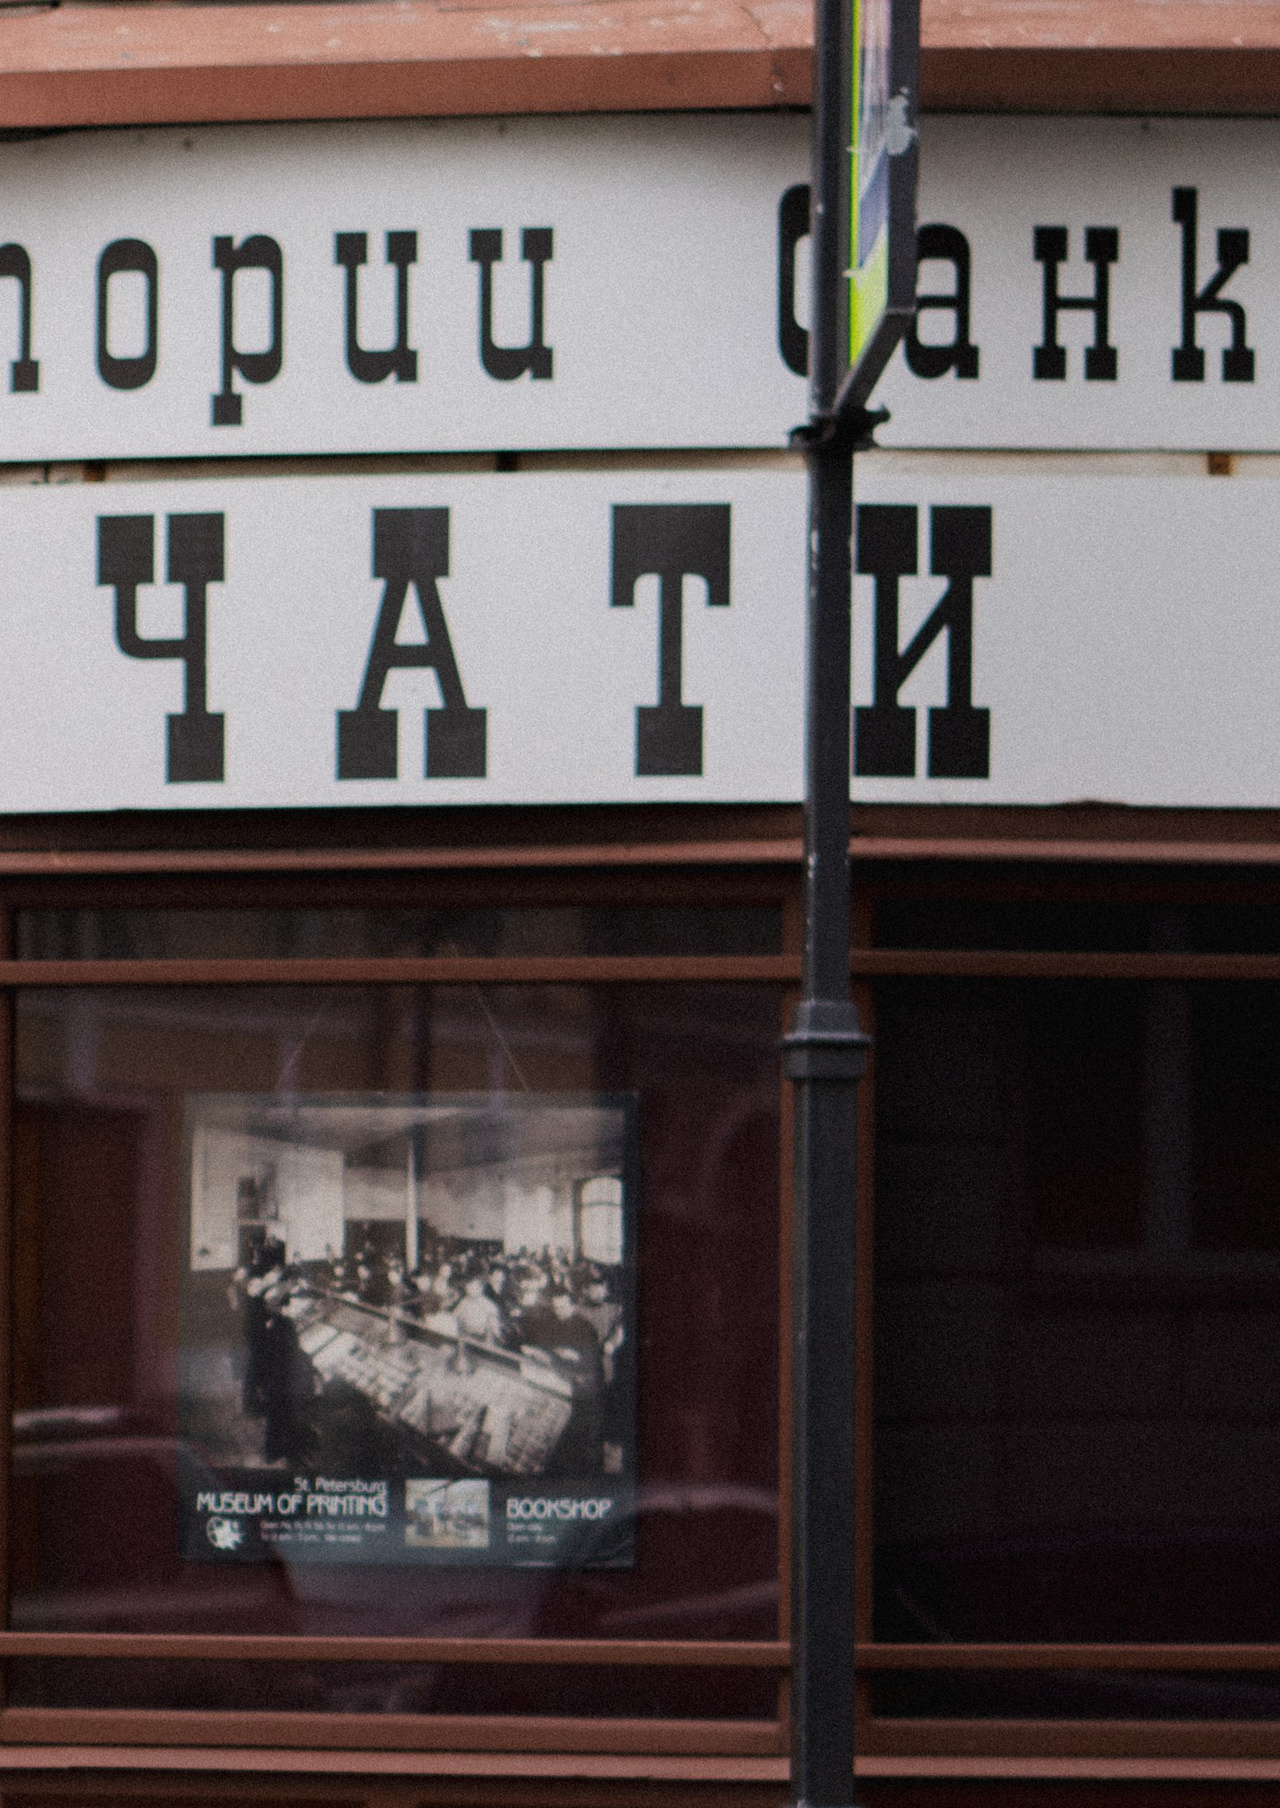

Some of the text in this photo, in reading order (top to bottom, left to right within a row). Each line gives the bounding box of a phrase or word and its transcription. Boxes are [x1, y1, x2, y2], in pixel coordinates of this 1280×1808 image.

[314, 1477, 387, 1497] Petersburg
[197, 1492, 387, 1518] MUSEUM OF PRINTING
[506, 1498, 612, 1519] BOOKSHOP
